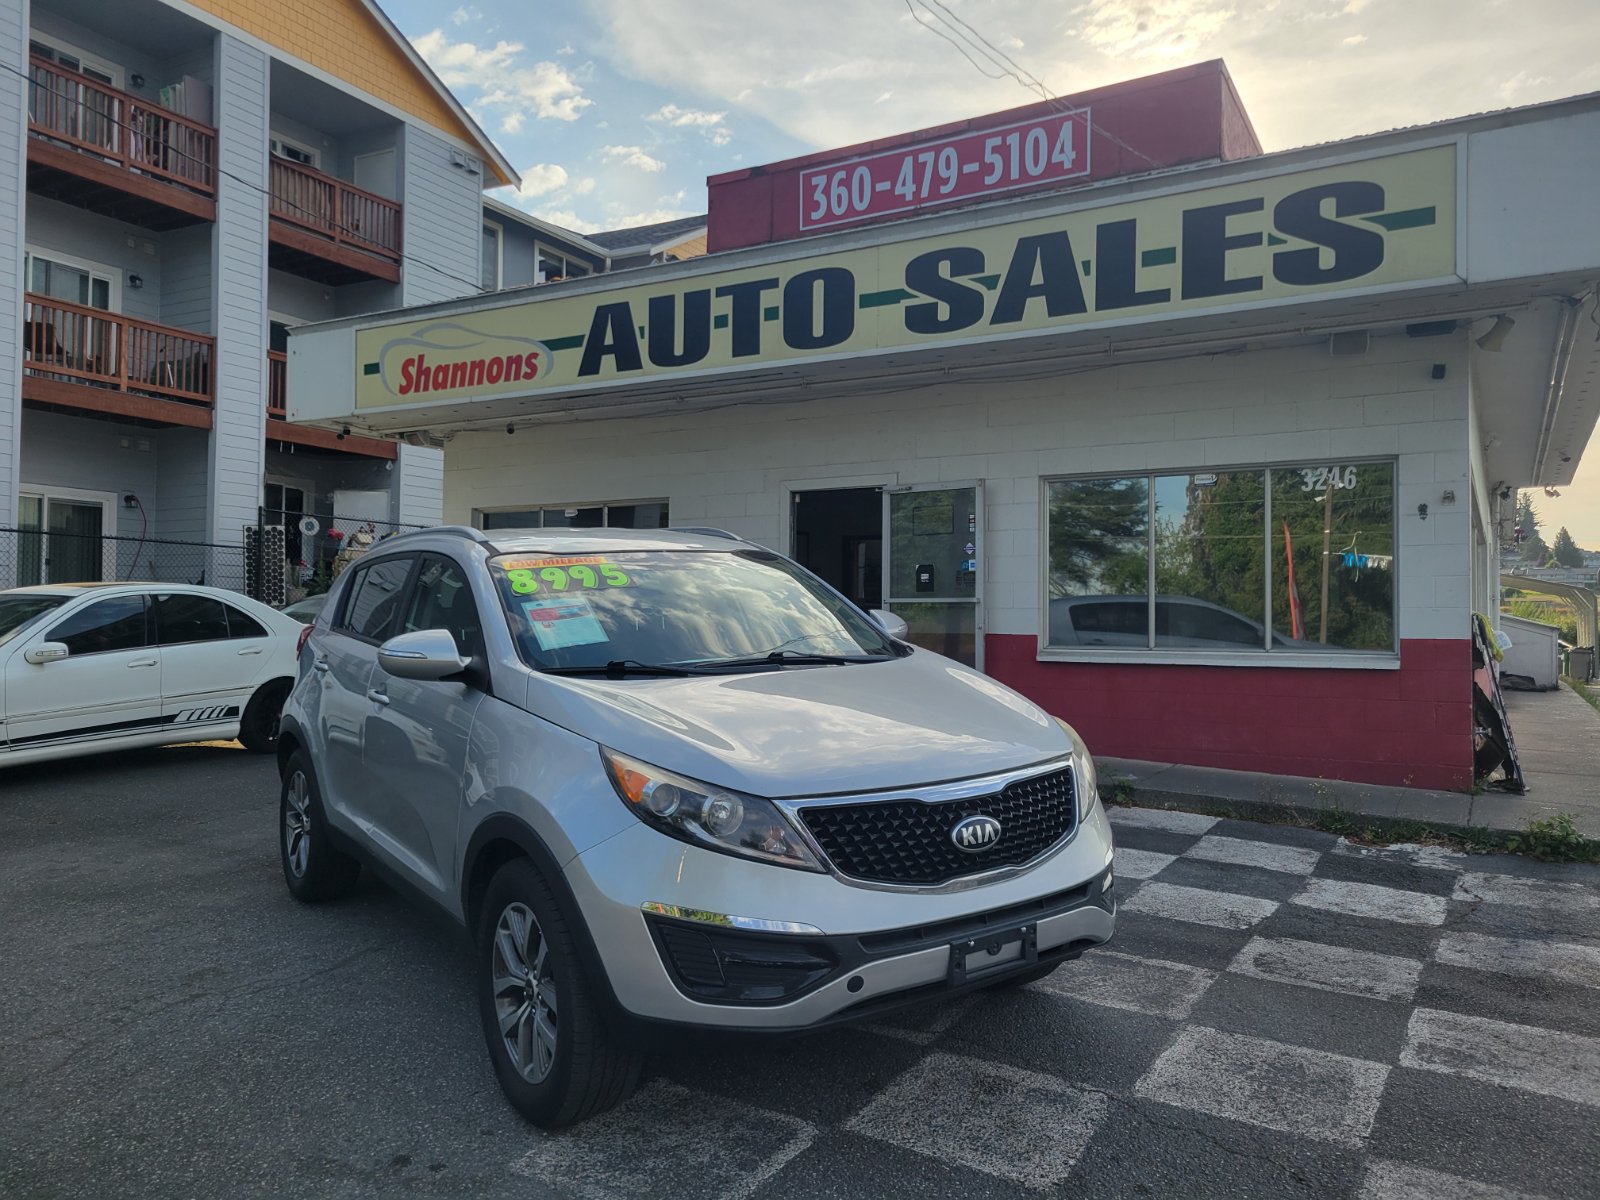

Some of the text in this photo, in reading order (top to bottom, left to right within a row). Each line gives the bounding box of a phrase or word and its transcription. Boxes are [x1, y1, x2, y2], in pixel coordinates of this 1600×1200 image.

[810, 120, 1076, 220] 360-479-5104
[398, 181, 1385, 396] Shannons AUTO SALES
[1300, 466, 1357, 491] 3246
[507, 564, 629, 595] 8995
[961, 823, 996, 846] KIA
